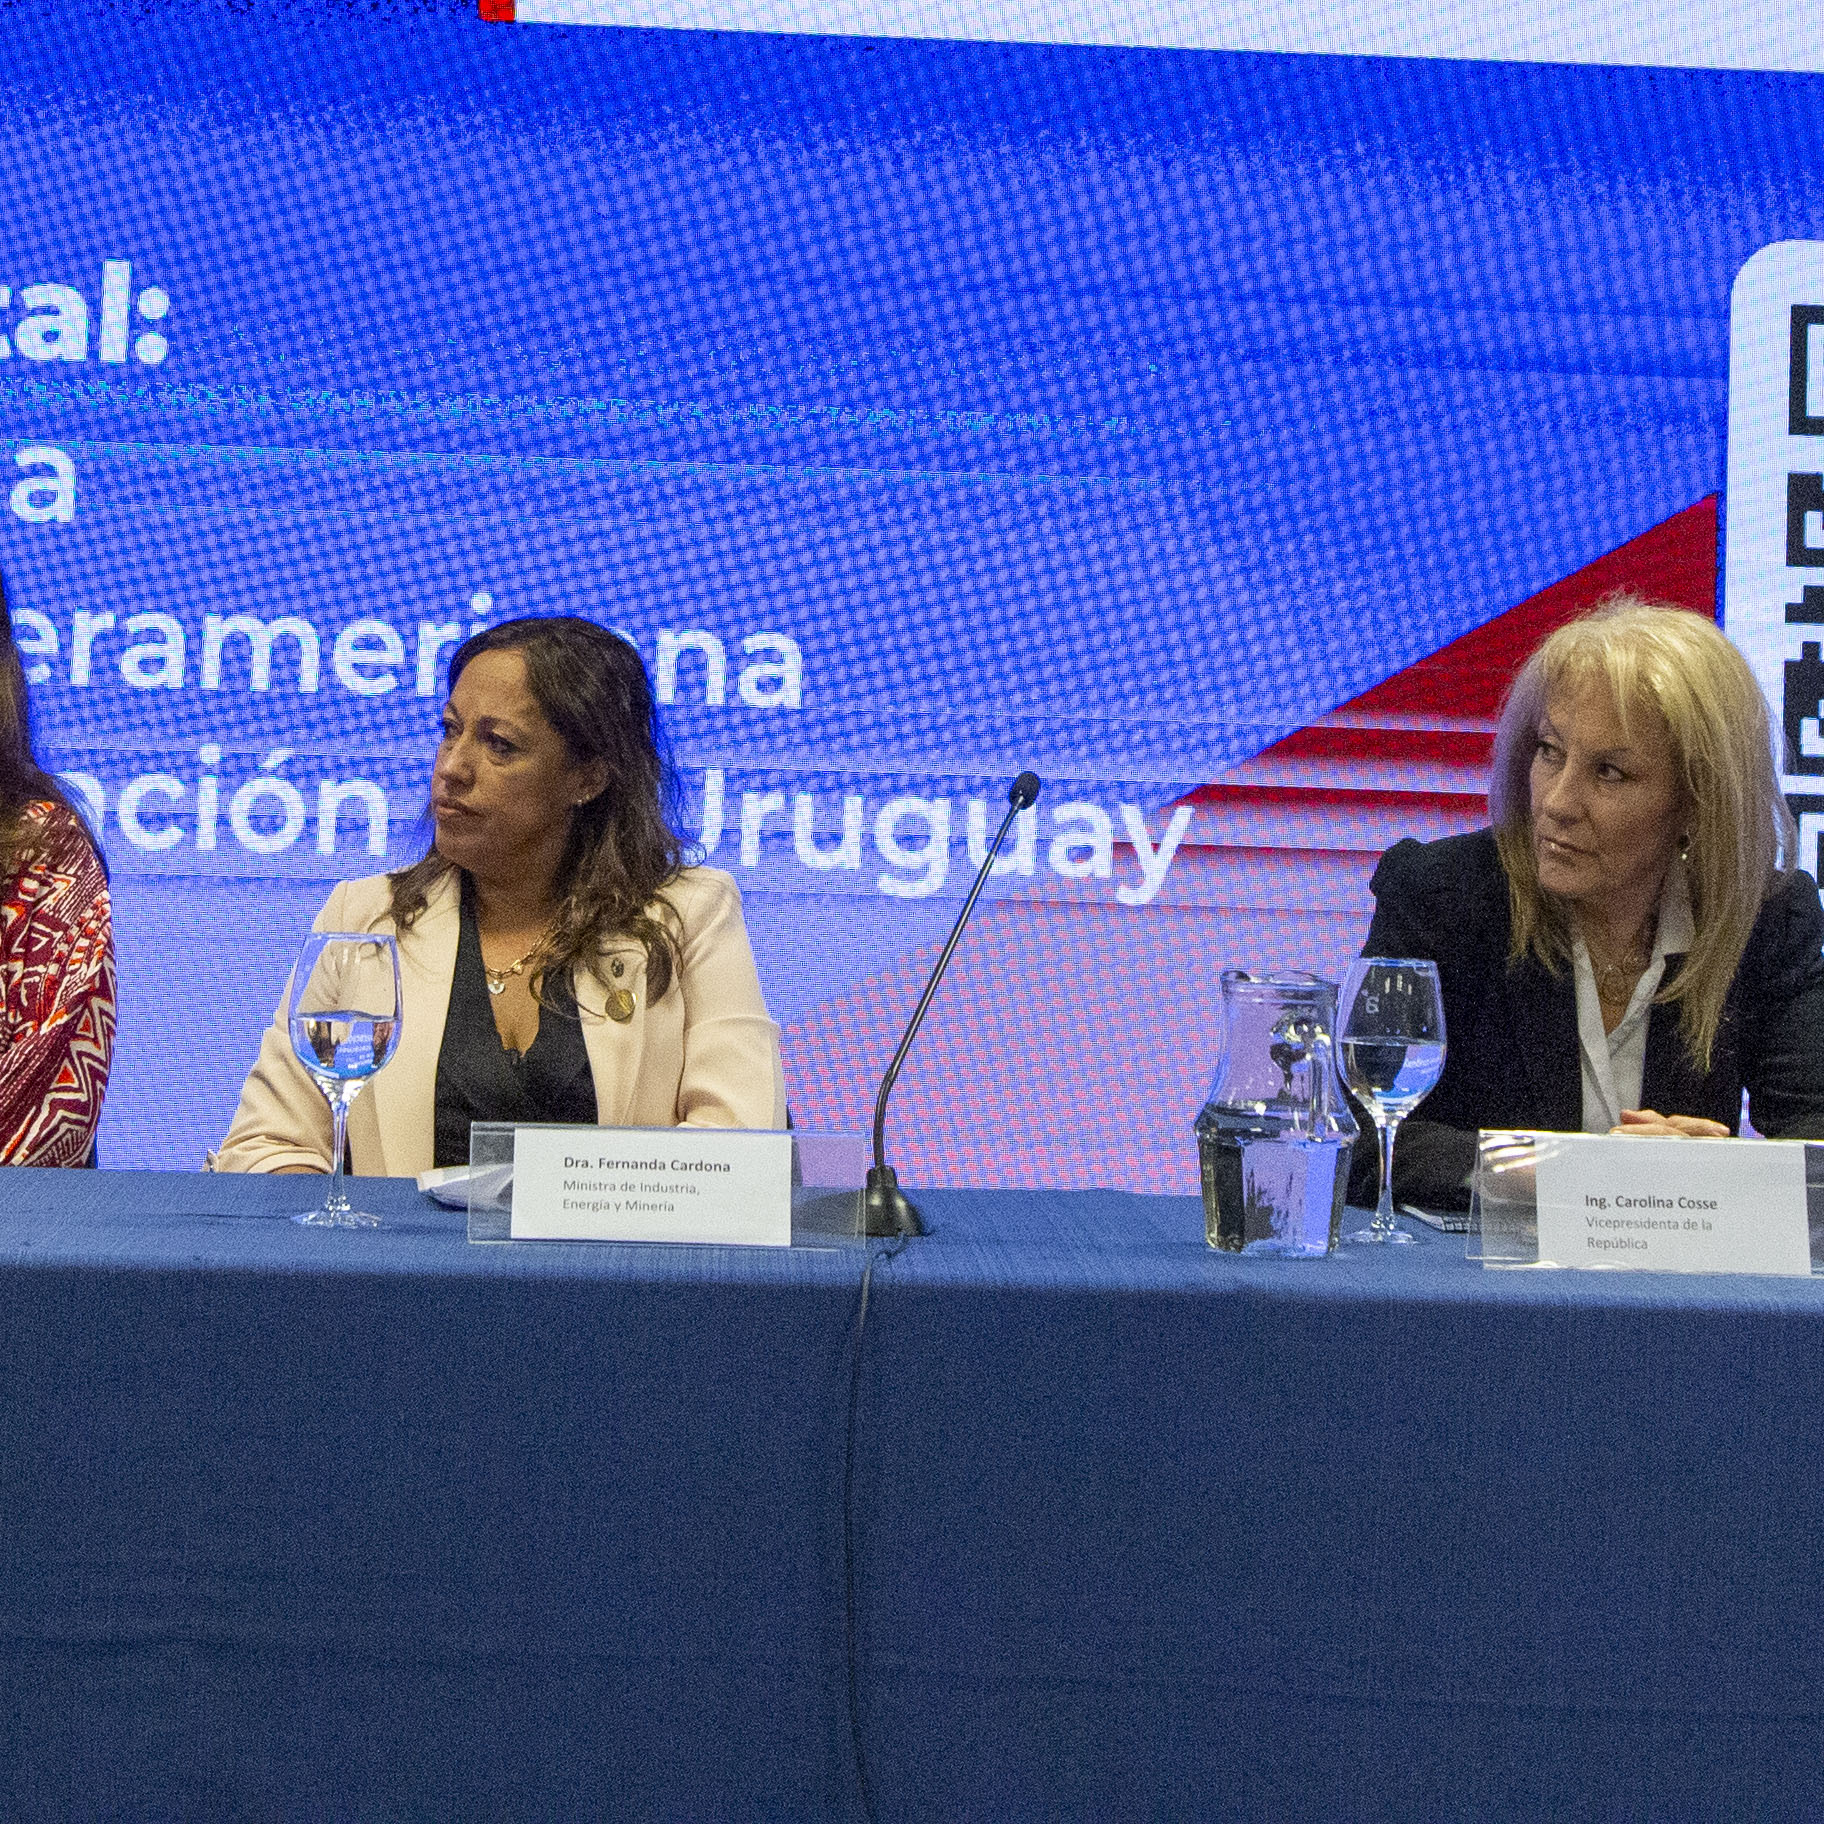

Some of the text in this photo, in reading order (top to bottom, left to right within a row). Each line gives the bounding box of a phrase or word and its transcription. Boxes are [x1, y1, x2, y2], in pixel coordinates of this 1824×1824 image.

[564, 1157, 730, 1173] Dra. Fernanda Cardona
[563, 1180, 700, 1196] Ministra de Industria,
[563, 1198, 675, 1213] Energía y Minería
[1585, 1195, 1718, 1211] Ing. Carolina Cosse
[1586, 1216, 1712, 1232] Vicepresidenta de la
[1587, 1236, 1648, 1251] República
